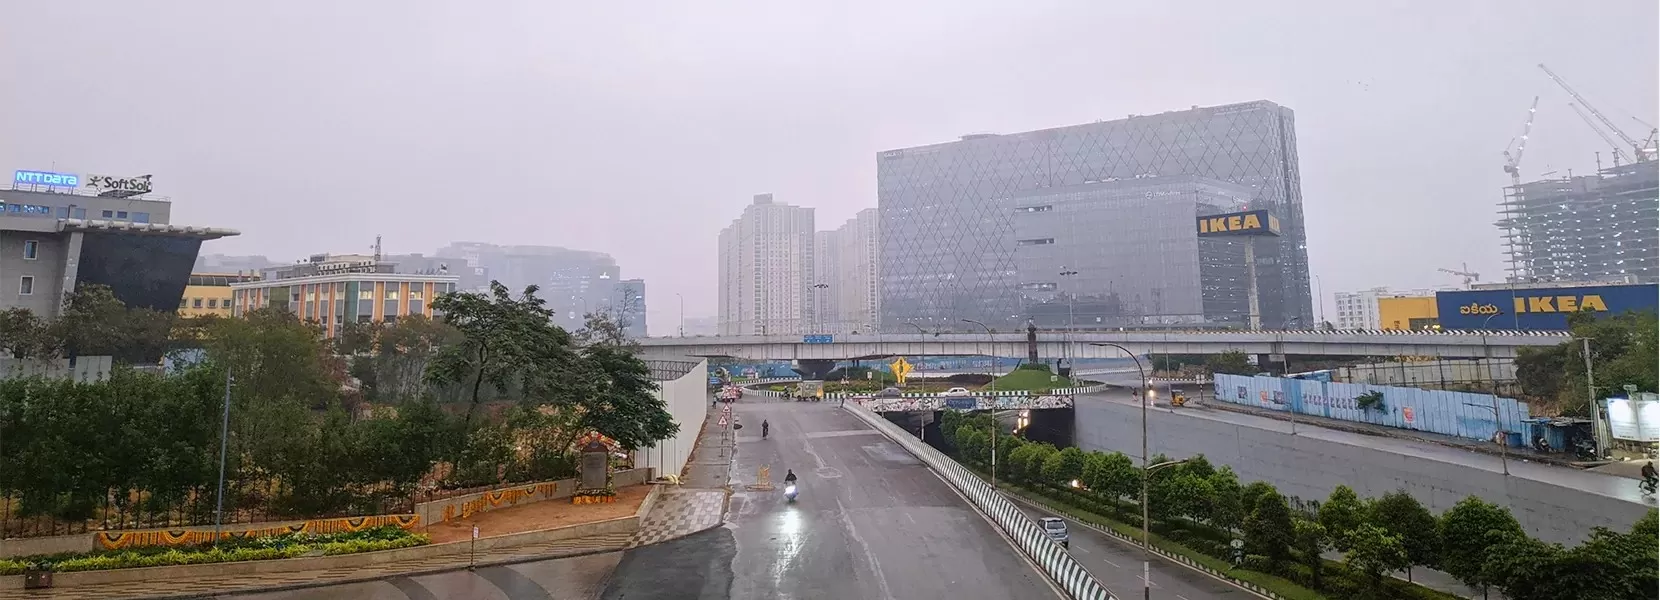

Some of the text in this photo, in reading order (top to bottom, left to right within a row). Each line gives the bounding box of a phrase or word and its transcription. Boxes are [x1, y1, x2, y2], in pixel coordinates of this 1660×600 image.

[16, 171, 43, 182] NTT
[1200, 214, 1261, 233] IKEA
[1514, 294, 1608, 312] IKEA
